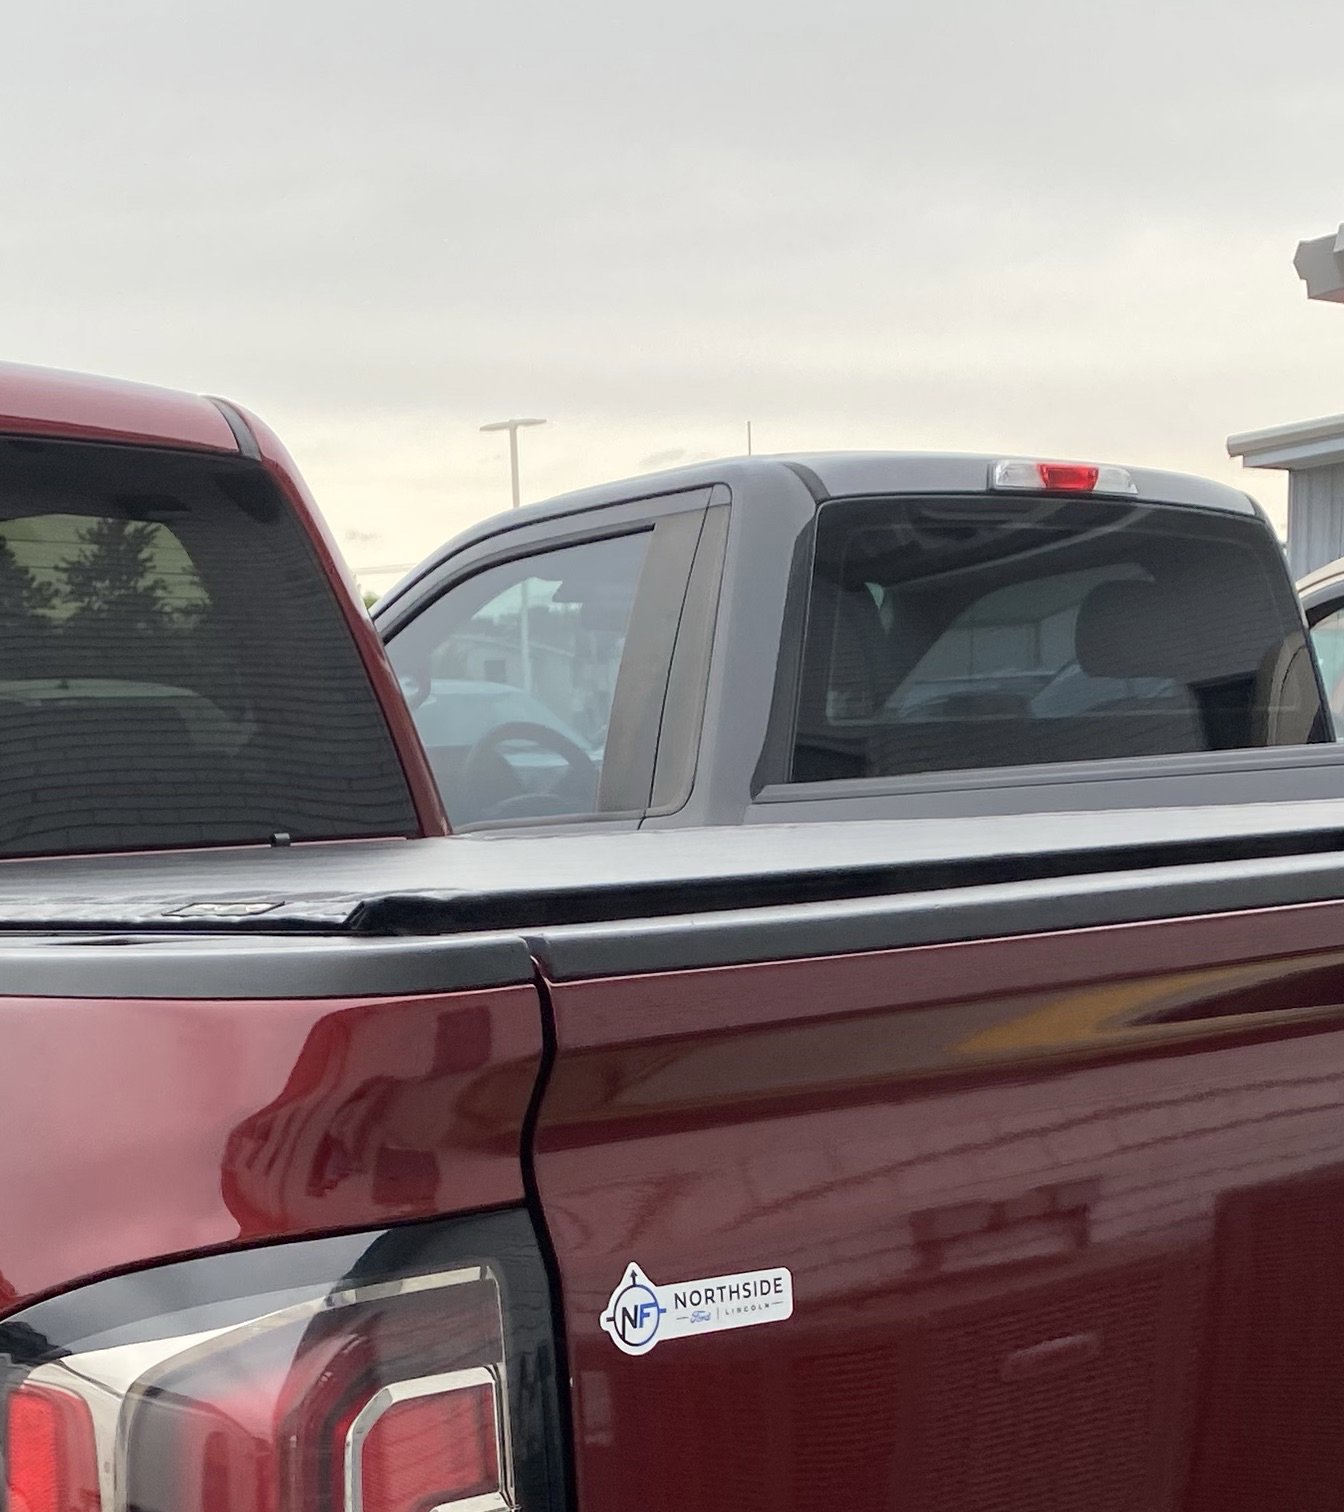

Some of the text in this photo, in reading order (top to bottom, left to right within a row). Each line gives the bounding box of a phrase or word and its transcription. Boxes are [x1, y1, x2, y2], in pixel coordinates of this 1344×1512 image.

[674, 1277, 784, 1309] NORTHSIDE
[621, 1302, 658, 1339] NF
[689, 1310, 712, 1324] Ford
